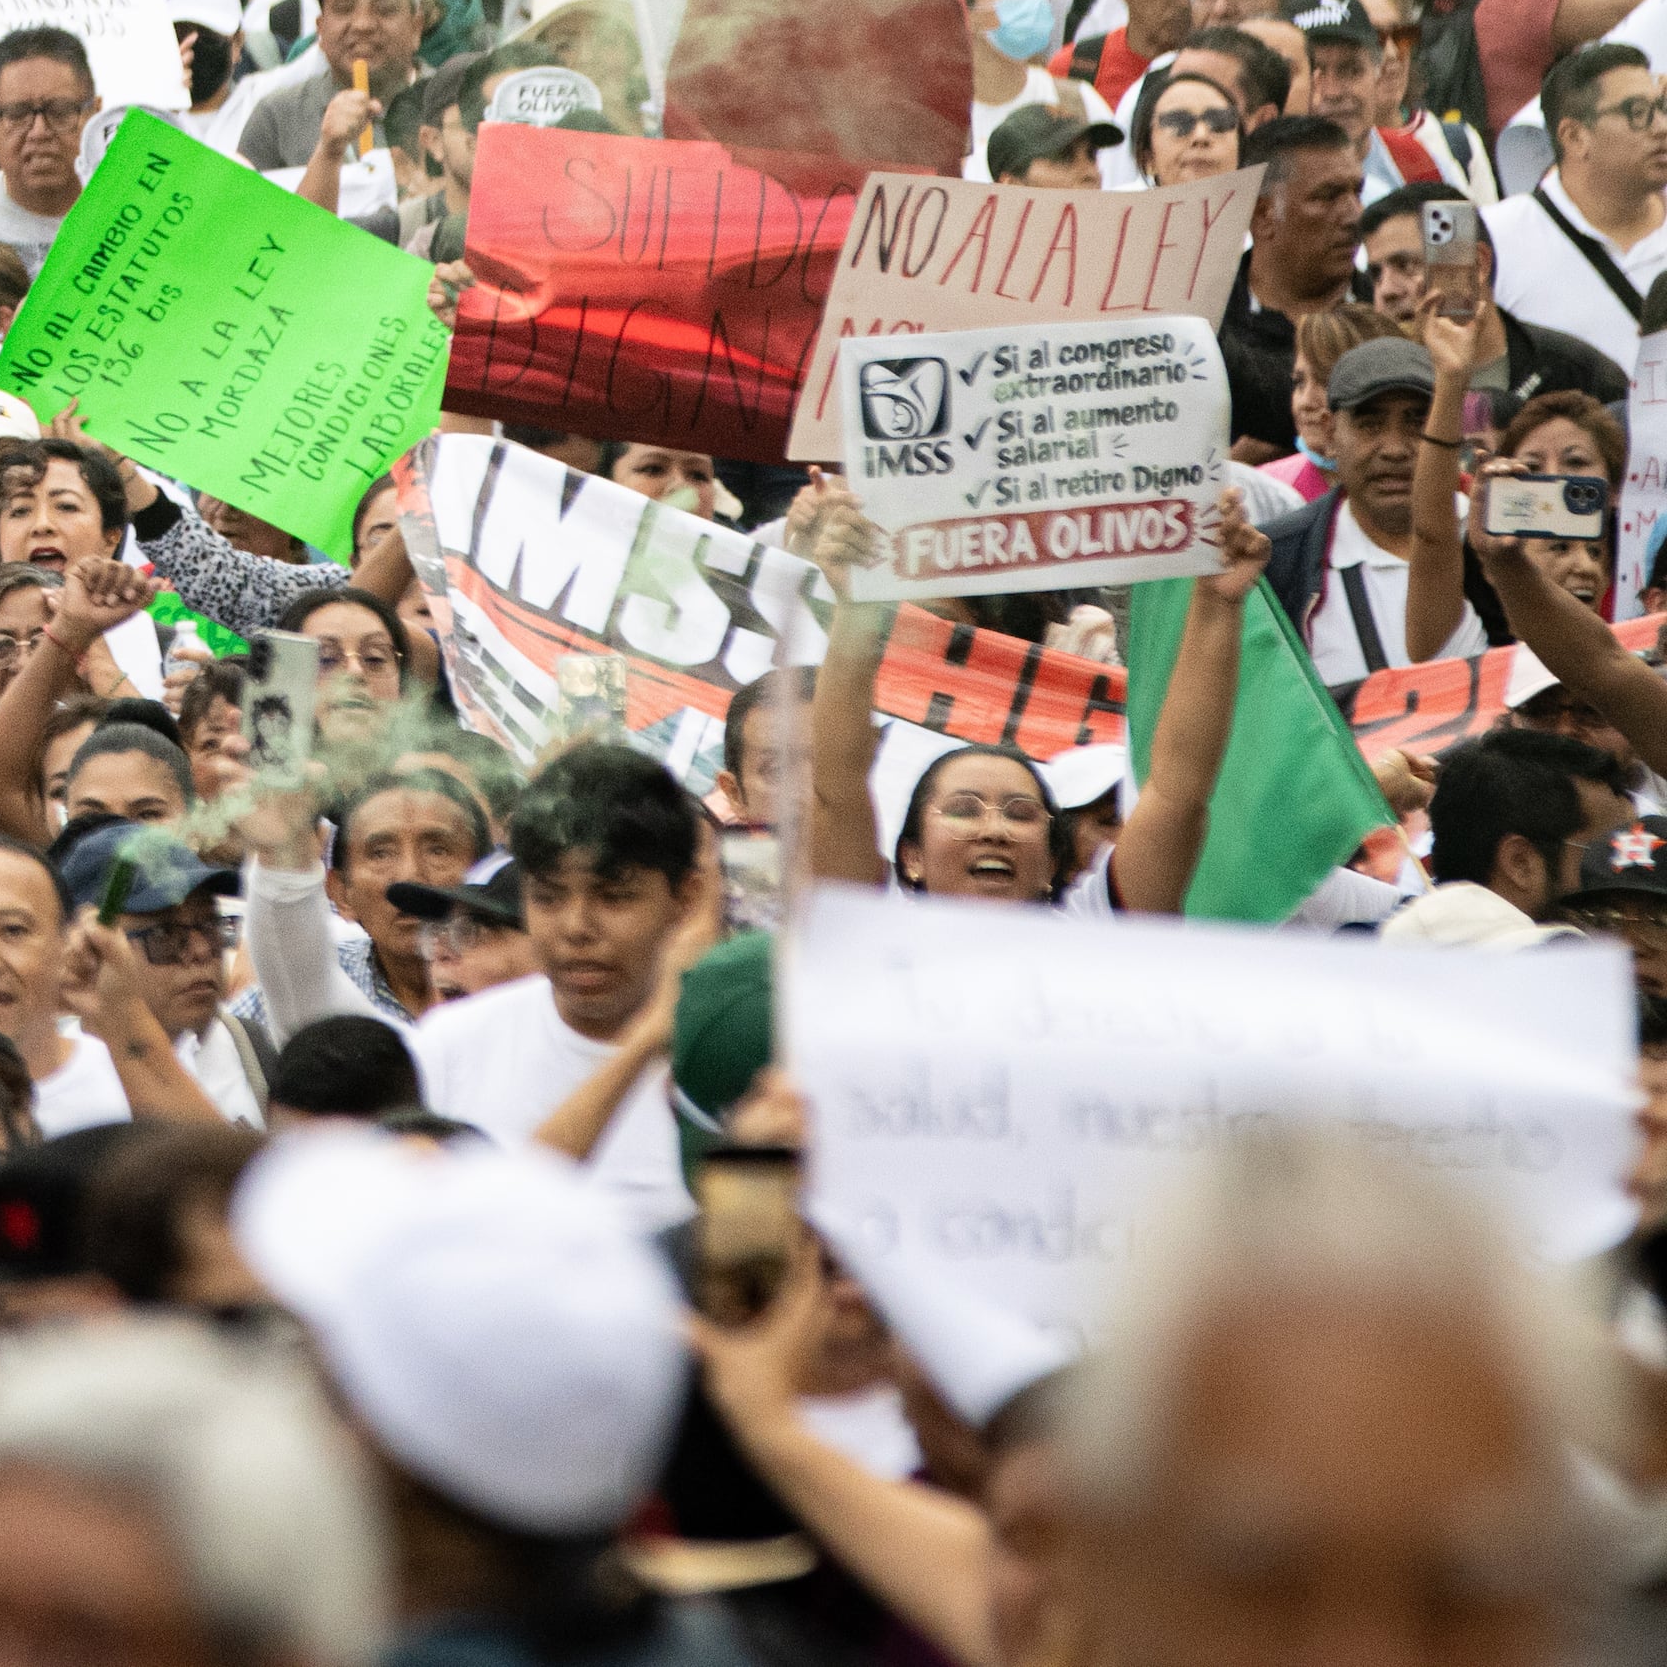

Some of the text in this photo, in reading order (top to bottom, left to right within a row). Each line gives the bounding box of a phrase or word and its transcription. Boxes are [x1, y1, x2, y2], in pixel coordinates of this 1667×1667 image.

[10, 151, 174, 390] NO AL CAMBIO EN
[52, 190, 195, 399] LOS ESTATUTOS
[851, 182, 950, 279] NO
[940, 193, 999, 294] A
[1099, 189, 1236, 312] LEY
[126, 233, 288, 456] NO A LA LEY
[198, 303, 295, 440] MORDAZA
[297, 314, 409, 483] CONDICIONES
[345, 318, 453, 481] LABORALES
[992, 331, 1177, 378] Si al congreso
[992, 358, 1188, 404] extraordinario
[240, 359, 348, 495] MEJORES
[865, 441, 955, 480] IMSS
[994, 462, 1205, 508] Si al retiro Digno
[995, 436, 1100, 472] salarial
[997, 397, 1179, 443] Si al aumento
[906, 506, 1191, 577] FUERA OLIVOS
